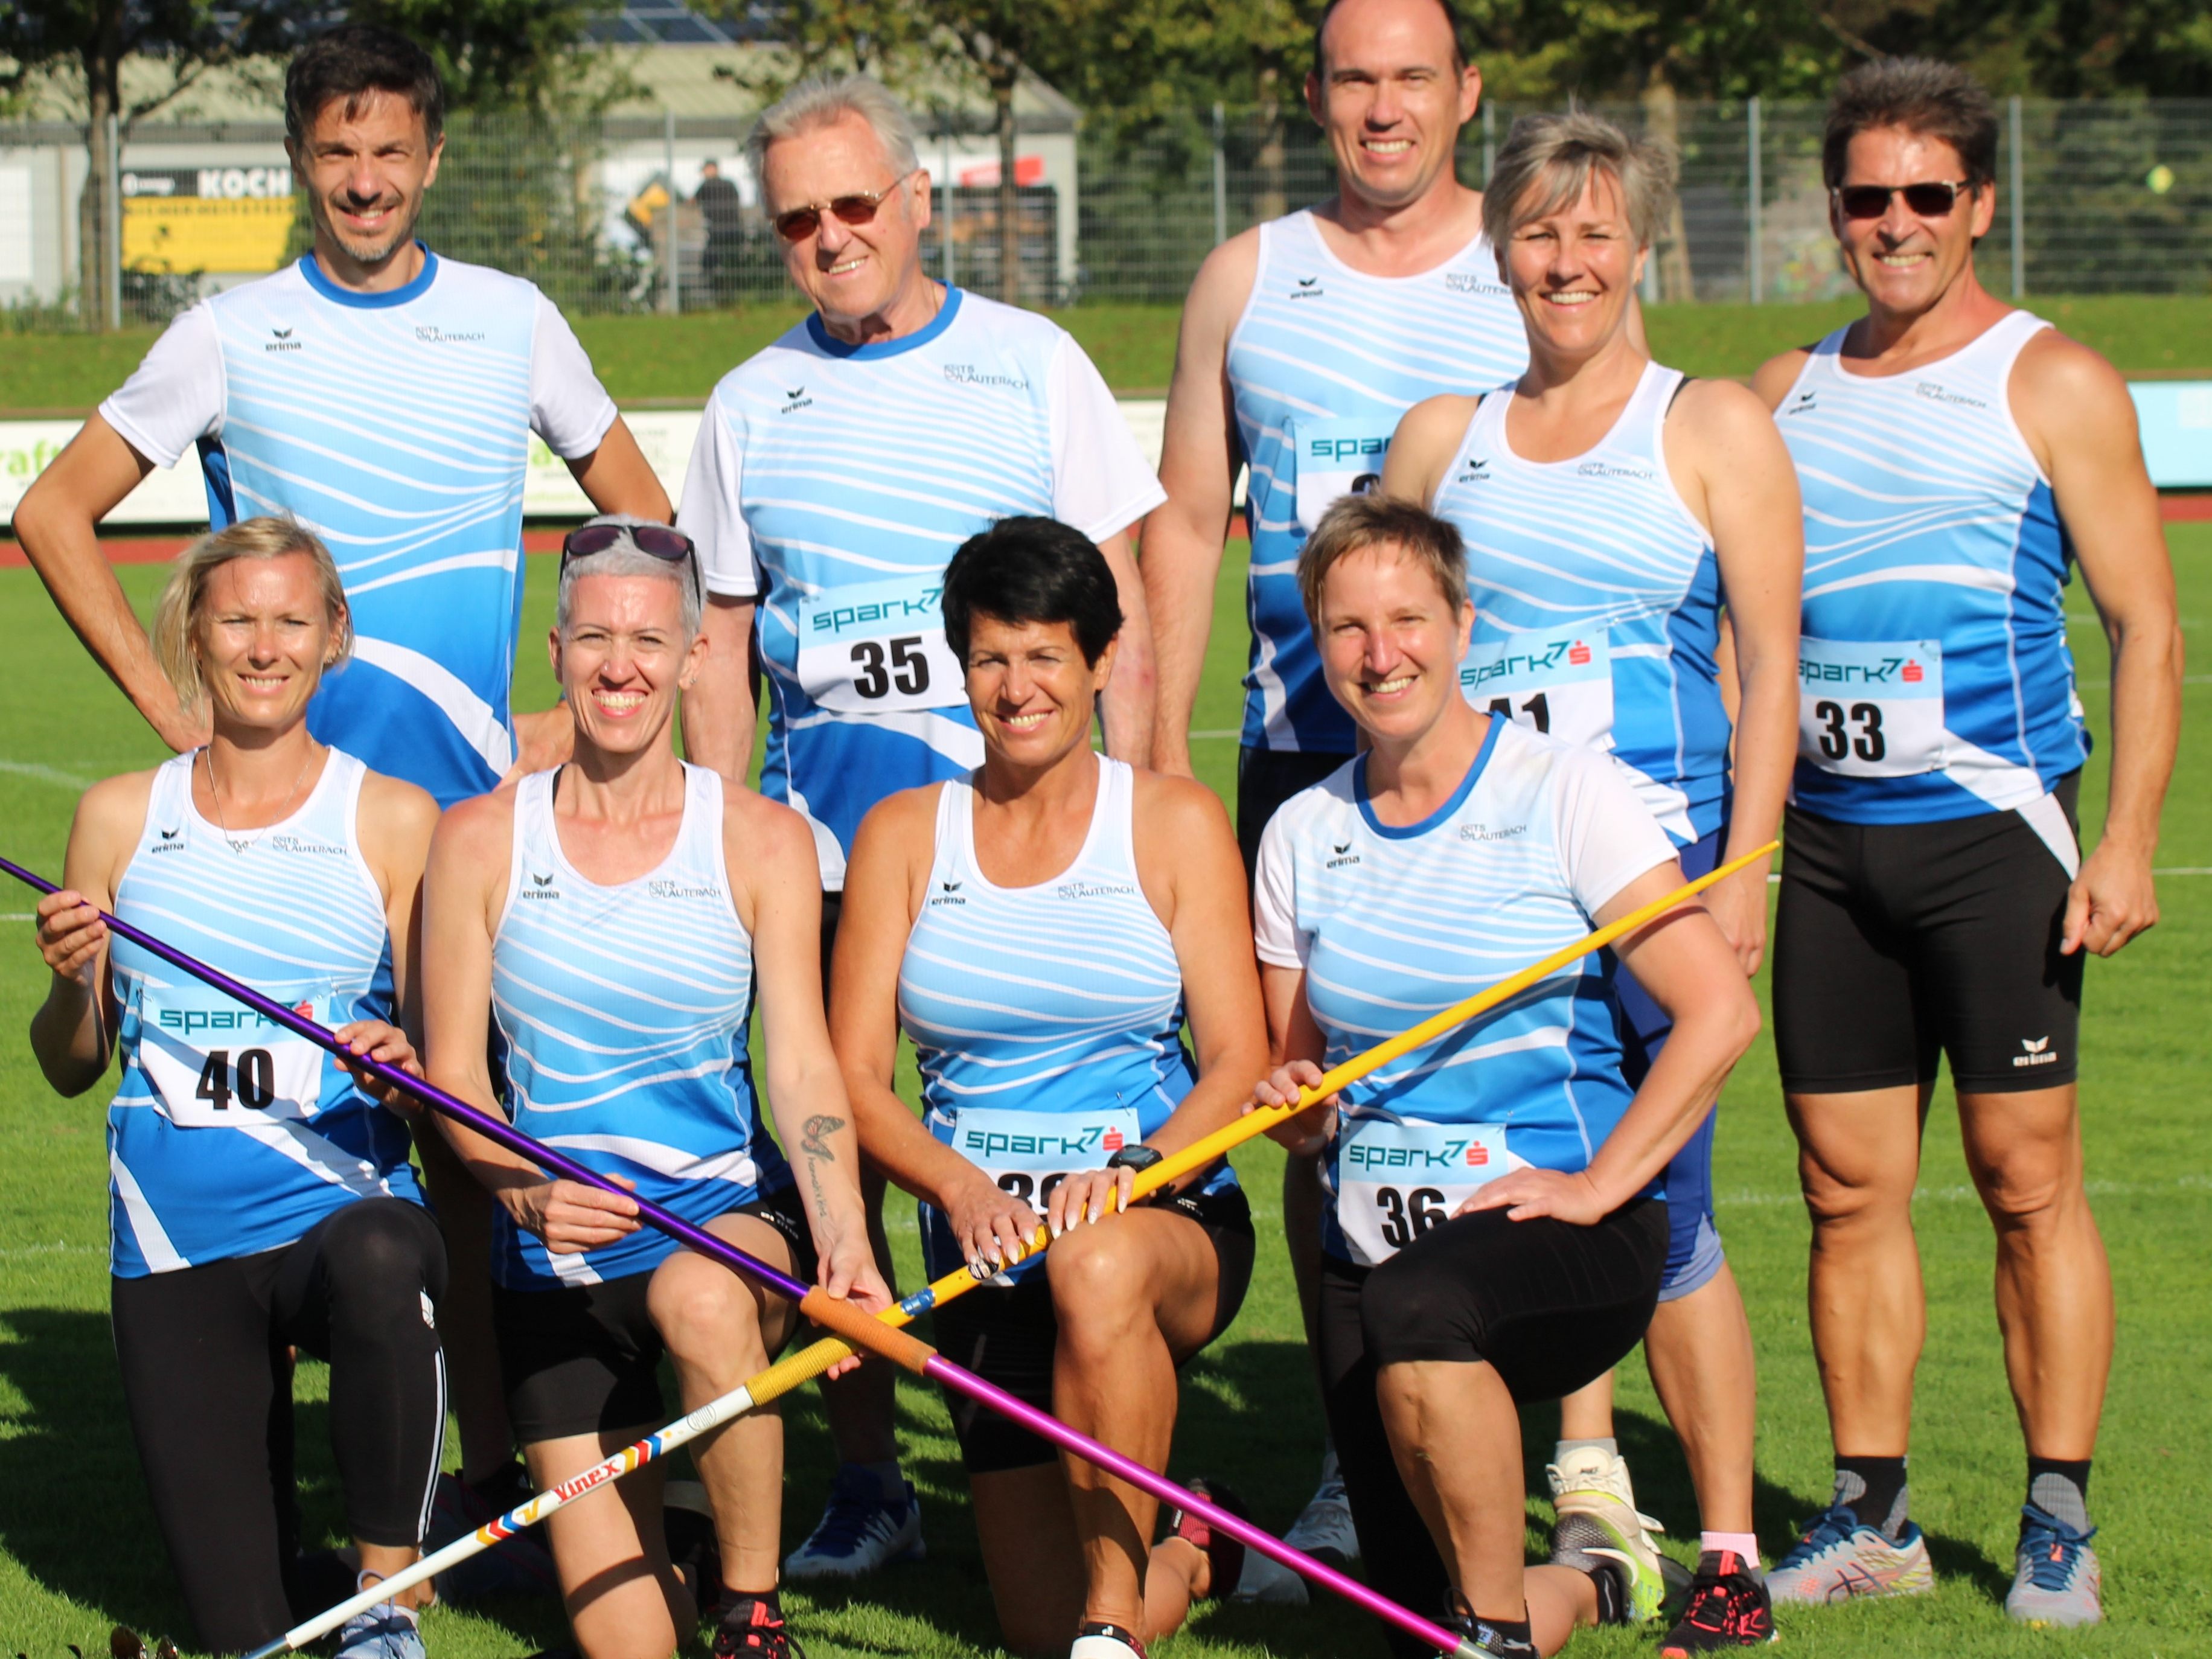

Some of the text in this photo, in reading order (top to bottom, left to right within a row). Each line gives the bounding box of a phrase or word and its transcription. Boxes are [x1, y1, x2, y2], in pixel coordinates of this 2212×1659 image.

[197, 169, 292, 199] KOCH
[265, 341, 301, 351] erima
[782, 398, 813, 415] erima
[851, 635, 929, 699] 35
[1816, 701, 1885, 762] 33
[152, 842, 184, 854] erima
[1327, 855, 1360, 869] erima
[522, 889, 560, 900] erima
[932, 895, 966, 906] erima
[196, 1048, 275, 1110] 40
[1376, 1187, 1450, 1248] 36
